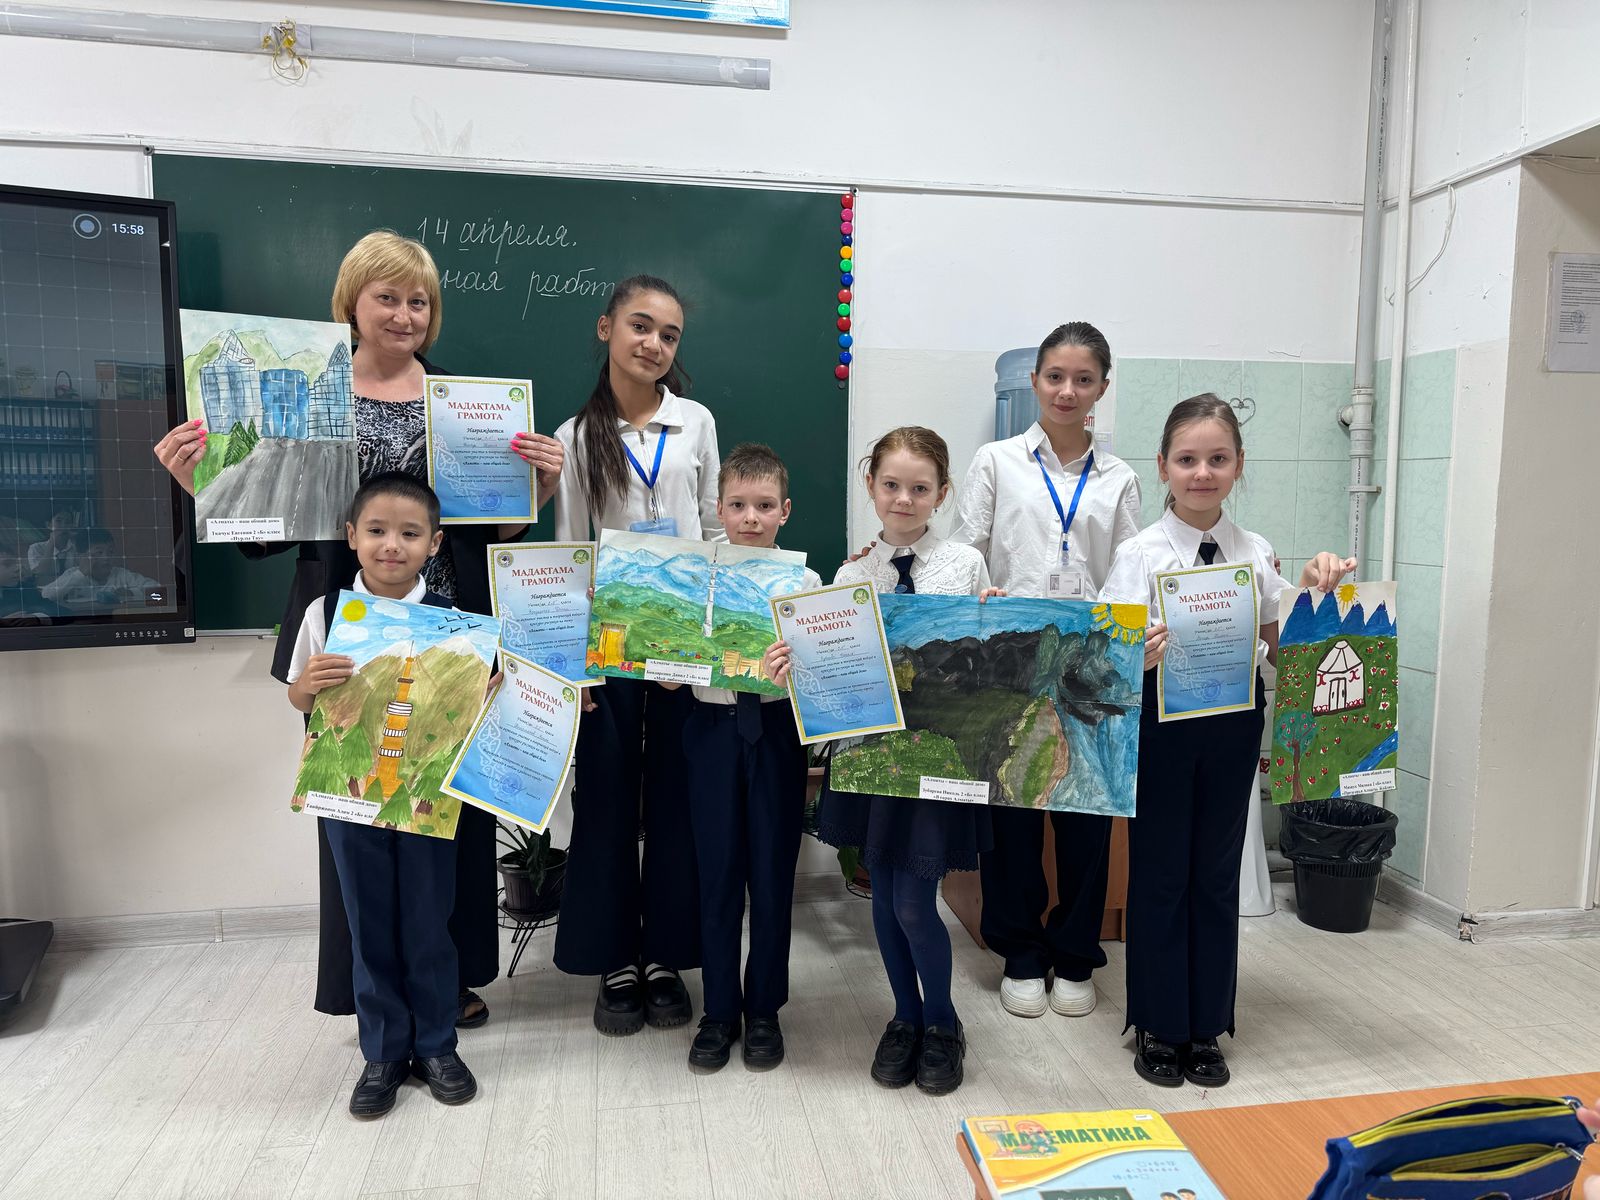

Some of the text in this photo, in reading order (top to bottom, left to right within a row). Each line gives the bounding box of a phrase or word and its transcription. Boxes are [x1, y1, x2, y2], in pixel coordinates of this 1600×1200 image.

[112, 223, 144, 235] 15:58
[417, 217, 449, 245] 14
[440, 267, 615, 320] ная работ
[457, 412, 503, 420] ГРАМОТА
[521, 577, 565, 586] ГРАМОТА
[1189, 601, 1231, 613] ГРАМОТА
[806, 620, 852, 635] ГРАМОТА
[520, 691, 555, 715] ГРАМОТА
[998, 1126, 1152, 1148] МАЕМАТИКА
